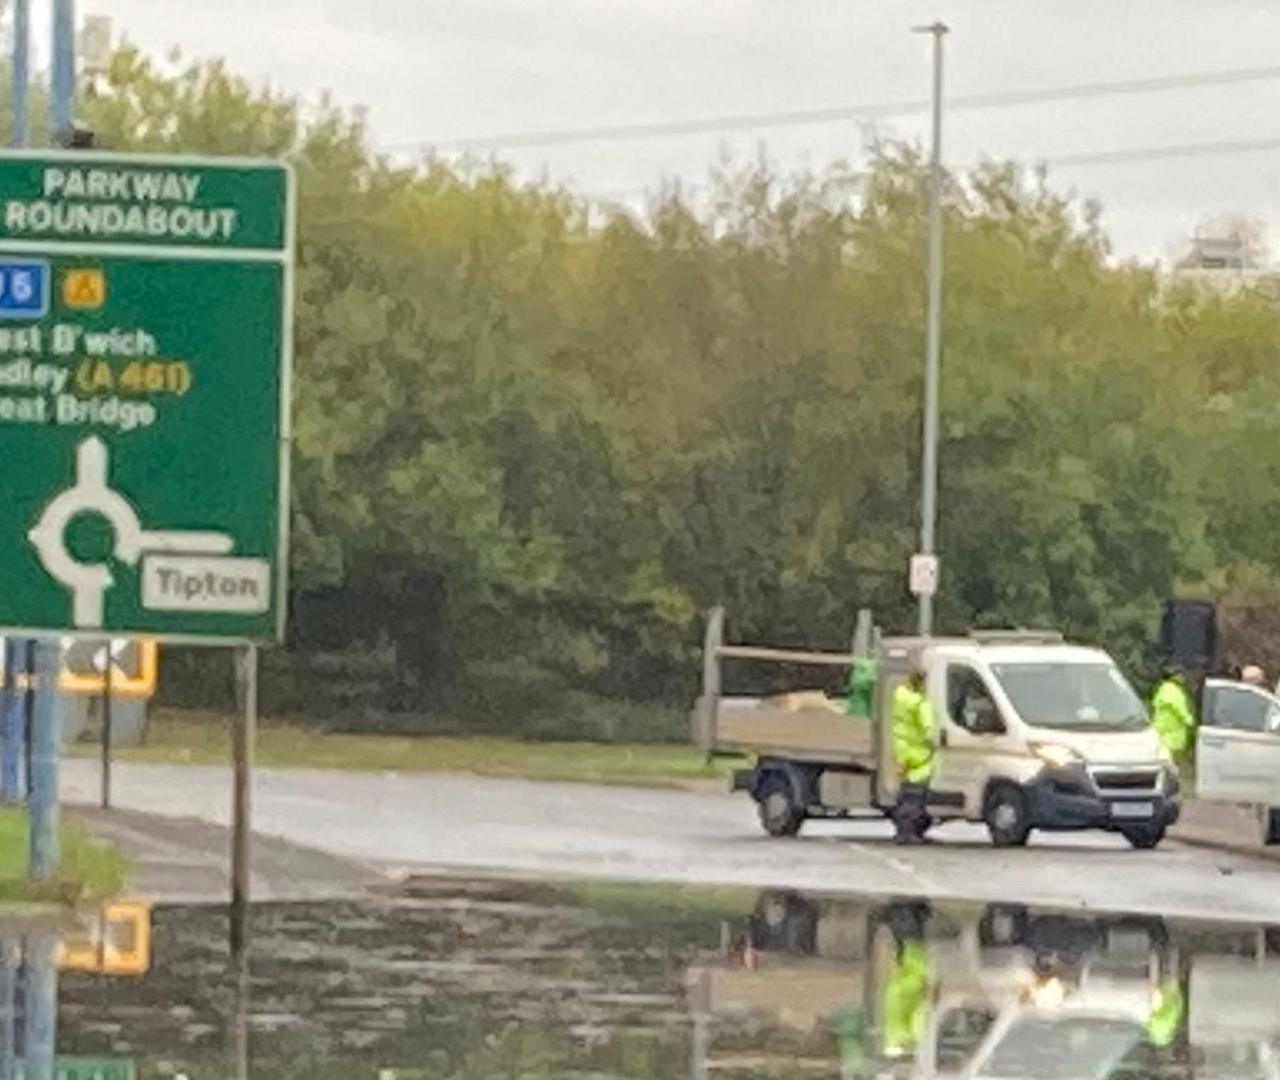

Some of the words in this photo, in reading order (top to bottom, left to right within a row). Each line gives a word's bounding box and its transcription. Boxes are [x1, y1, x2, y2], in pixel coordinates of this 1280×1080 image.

[44, 167, 200, 201] PARKWAY
[5, 201, 237, 239] ROUNDABOUT
[56, 395, 156, 432] Bridge
[153, 568, 258, 599] Tipton
